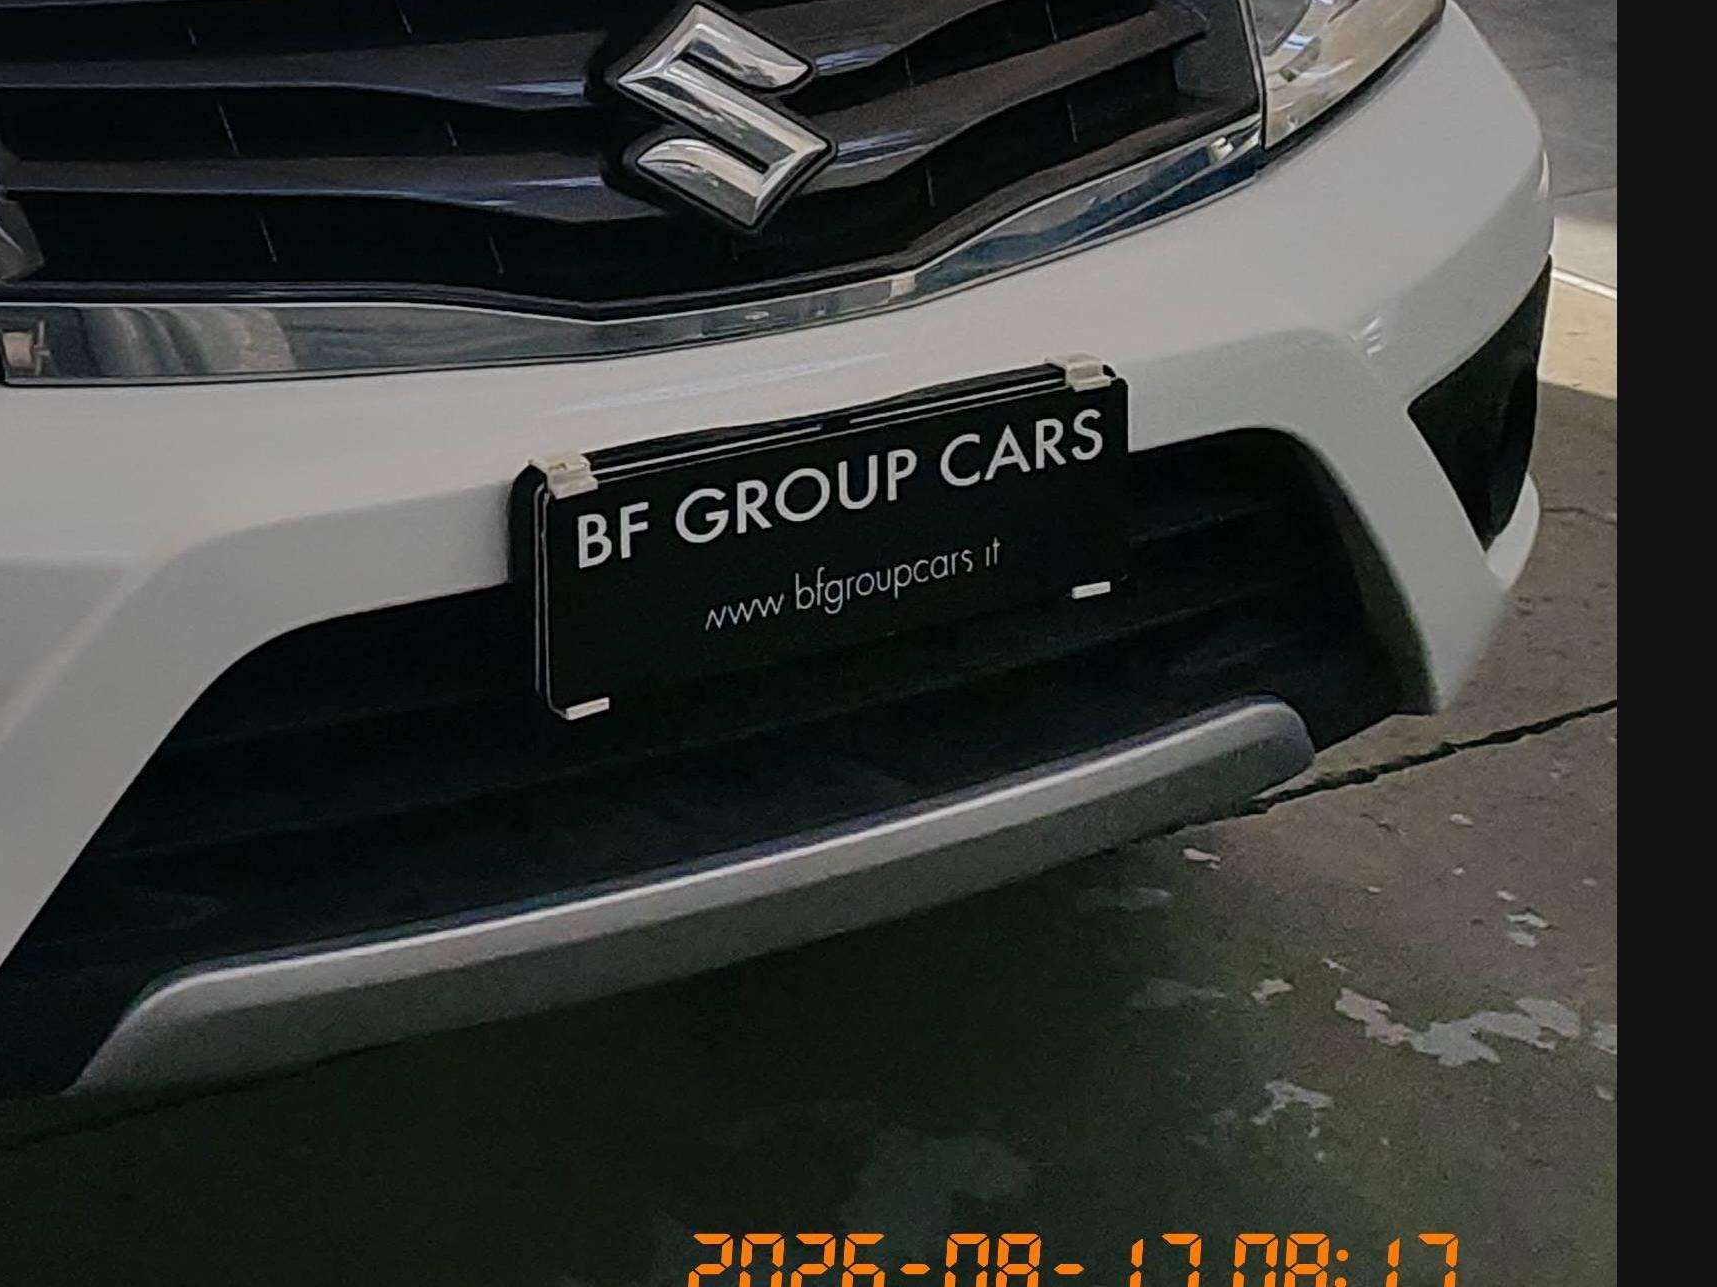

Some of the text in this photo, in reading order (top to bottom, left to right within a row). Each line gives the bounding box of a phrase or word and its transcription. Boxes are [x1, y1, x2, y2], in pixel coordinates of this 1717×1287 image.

[577, 408, 1104, 569] BF GROUP CARS
